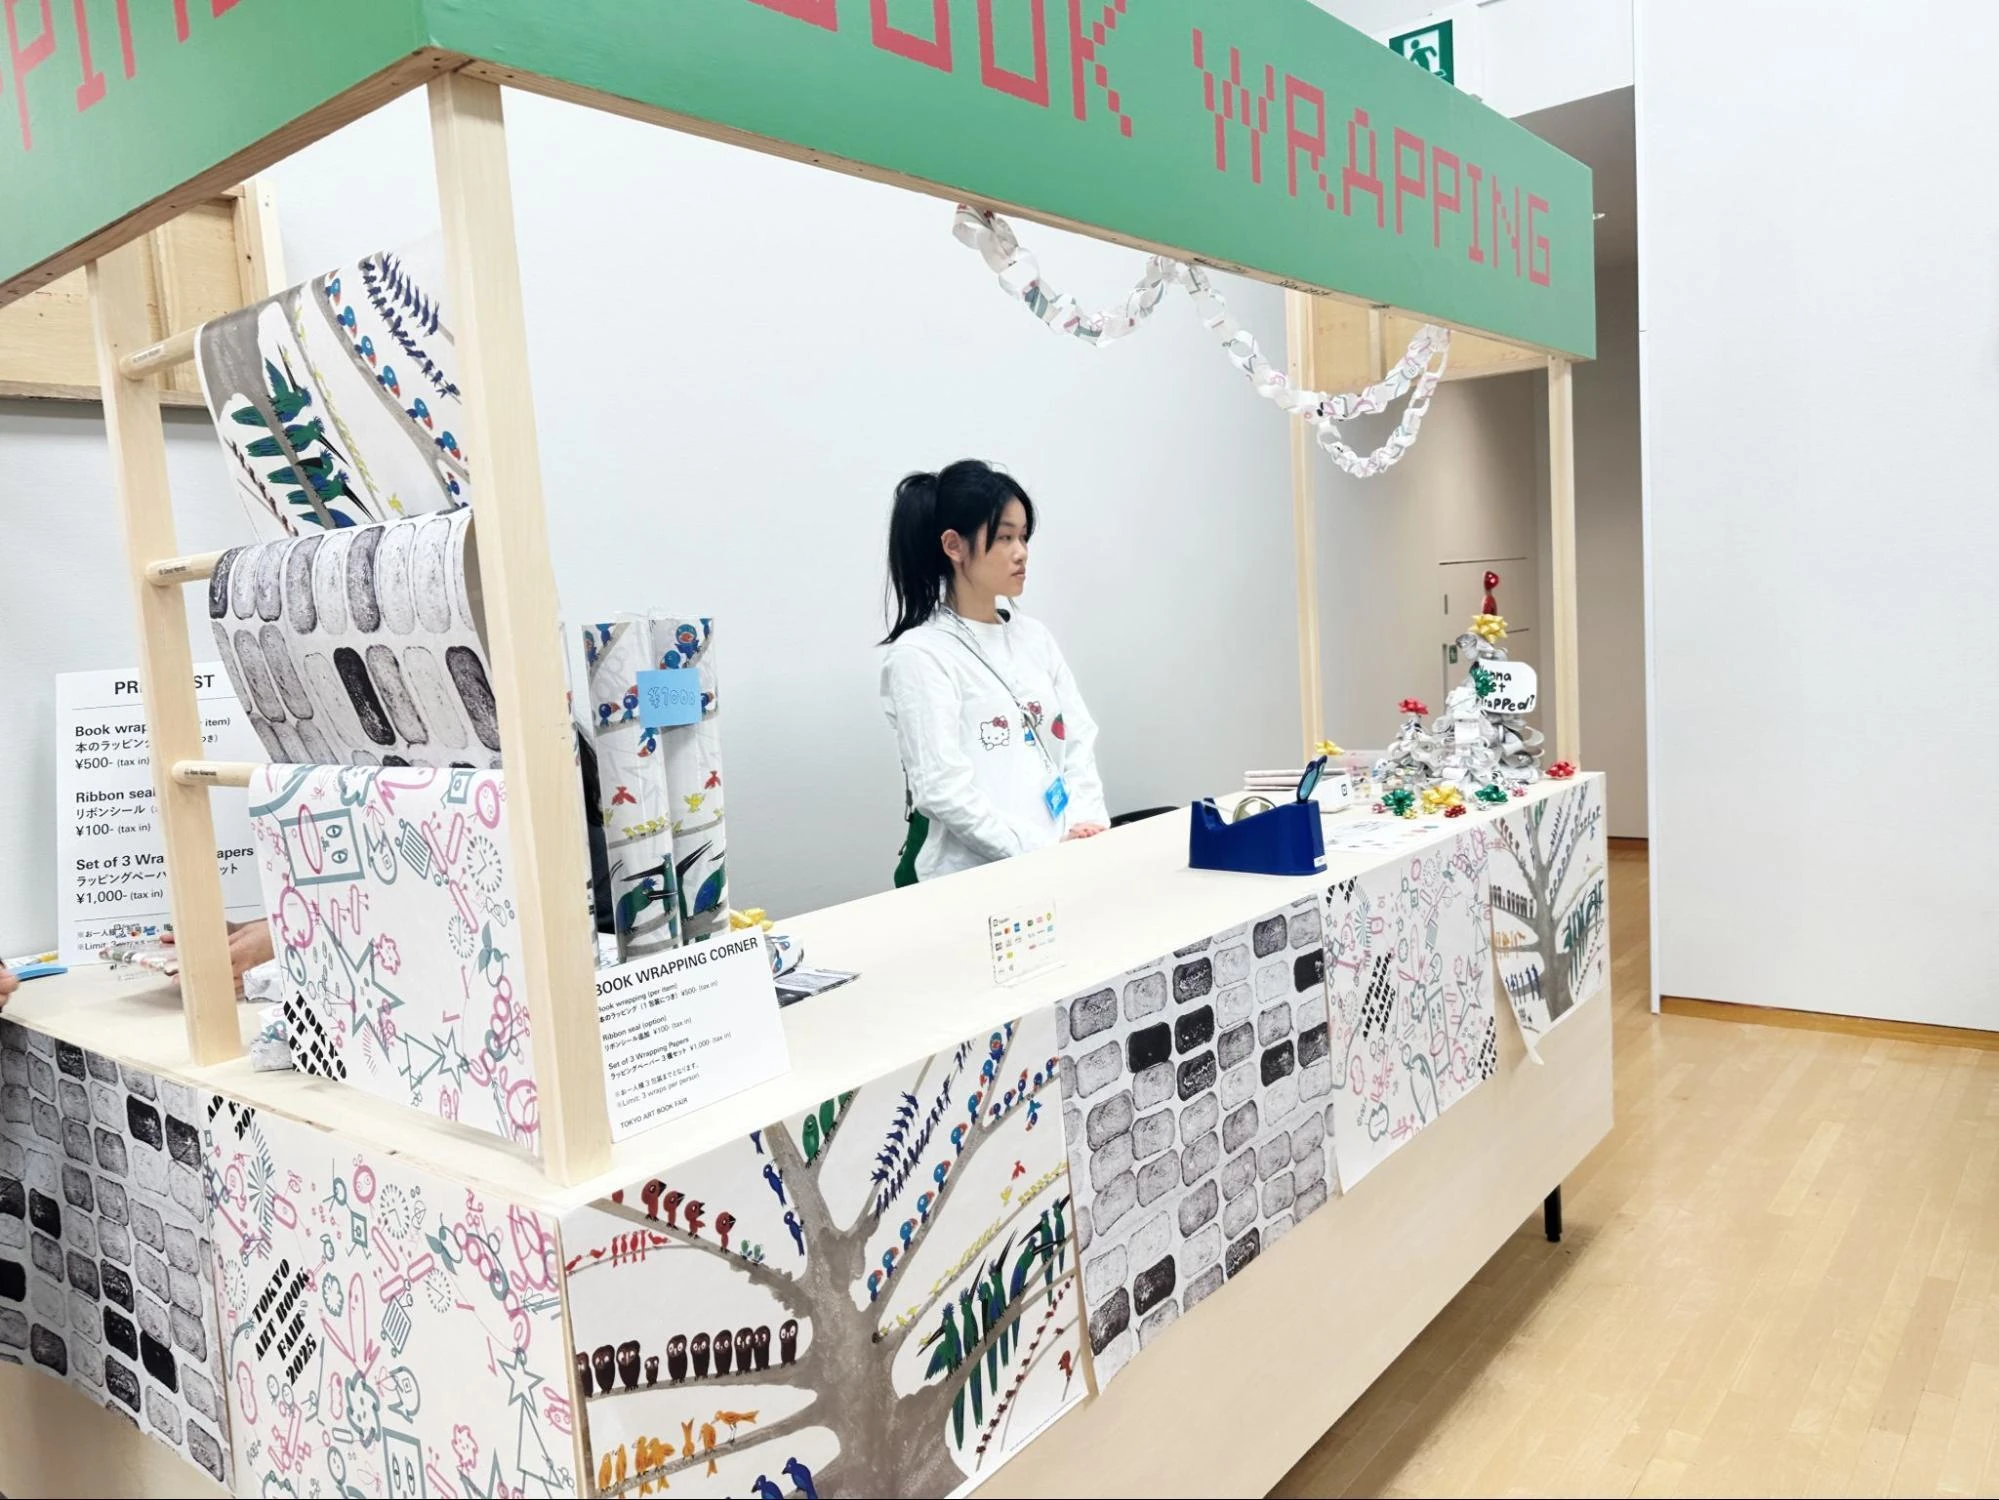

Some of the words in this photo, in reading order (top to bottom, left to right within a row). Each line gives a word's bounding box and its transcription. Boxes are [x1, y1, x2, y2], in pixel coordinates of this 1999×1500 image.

[1192, 28, 1551, 287] WRAPPING
[193, 674, 215, 689] ST
[75, 723, 110, 738] Book
[75, 739, 150, 755] 本のラッピン
[117, 759, 135, 768] (tax
[137, 757, 150, 767] in)
[76, 790, 124, 804] Ribbon
[118, 825, 136, 835] (tax
[139, 823, 151, 832] in)
[76, 858, 99, 871] Set
[103, 856, 118, 869] of
[121, 855, 131, 867] 3
[217, 846, 255, 861] apers
[130, 892, 148, 902] (tax
[151, 889, 164, 900] in)
[635, 951, 707, 984] WRAPPING
[709, 936, 759, 962] CORNER
[616, 993, 646, 1009] wrapping
[602, 1029, 627, 1042] Ribbon
[628, 1023, 641, 1033] seal
[642, 1015, 667, 1029] (option)
[608, 1061, 620, 1071] Set
[621, 1058, 629, 1066] of
[630, 1055, 635, 1063] 3
[635, 1045, 668, 1060] Wrapping
[641, 1091, 647, 1100] 3
[647, 1086, 667, 1098] wraps
[668, 1081, 678, 1091] per
[620, 1115, 642, 1129] TOKYO
[643, 1110, 655, 1120] ART
[656, 1103, 674, 1115] BOOK
[674, 1097, 689, 1107] FAIR
[252, 1258, 290, 1324] TOKYO
[255, 1317, 277, 1362] ART
[276, 1265, 310, 1325] BOOK
[277, 1311, 305, 1361] FAIR
[286, 1332, 317, 1388] 2025
